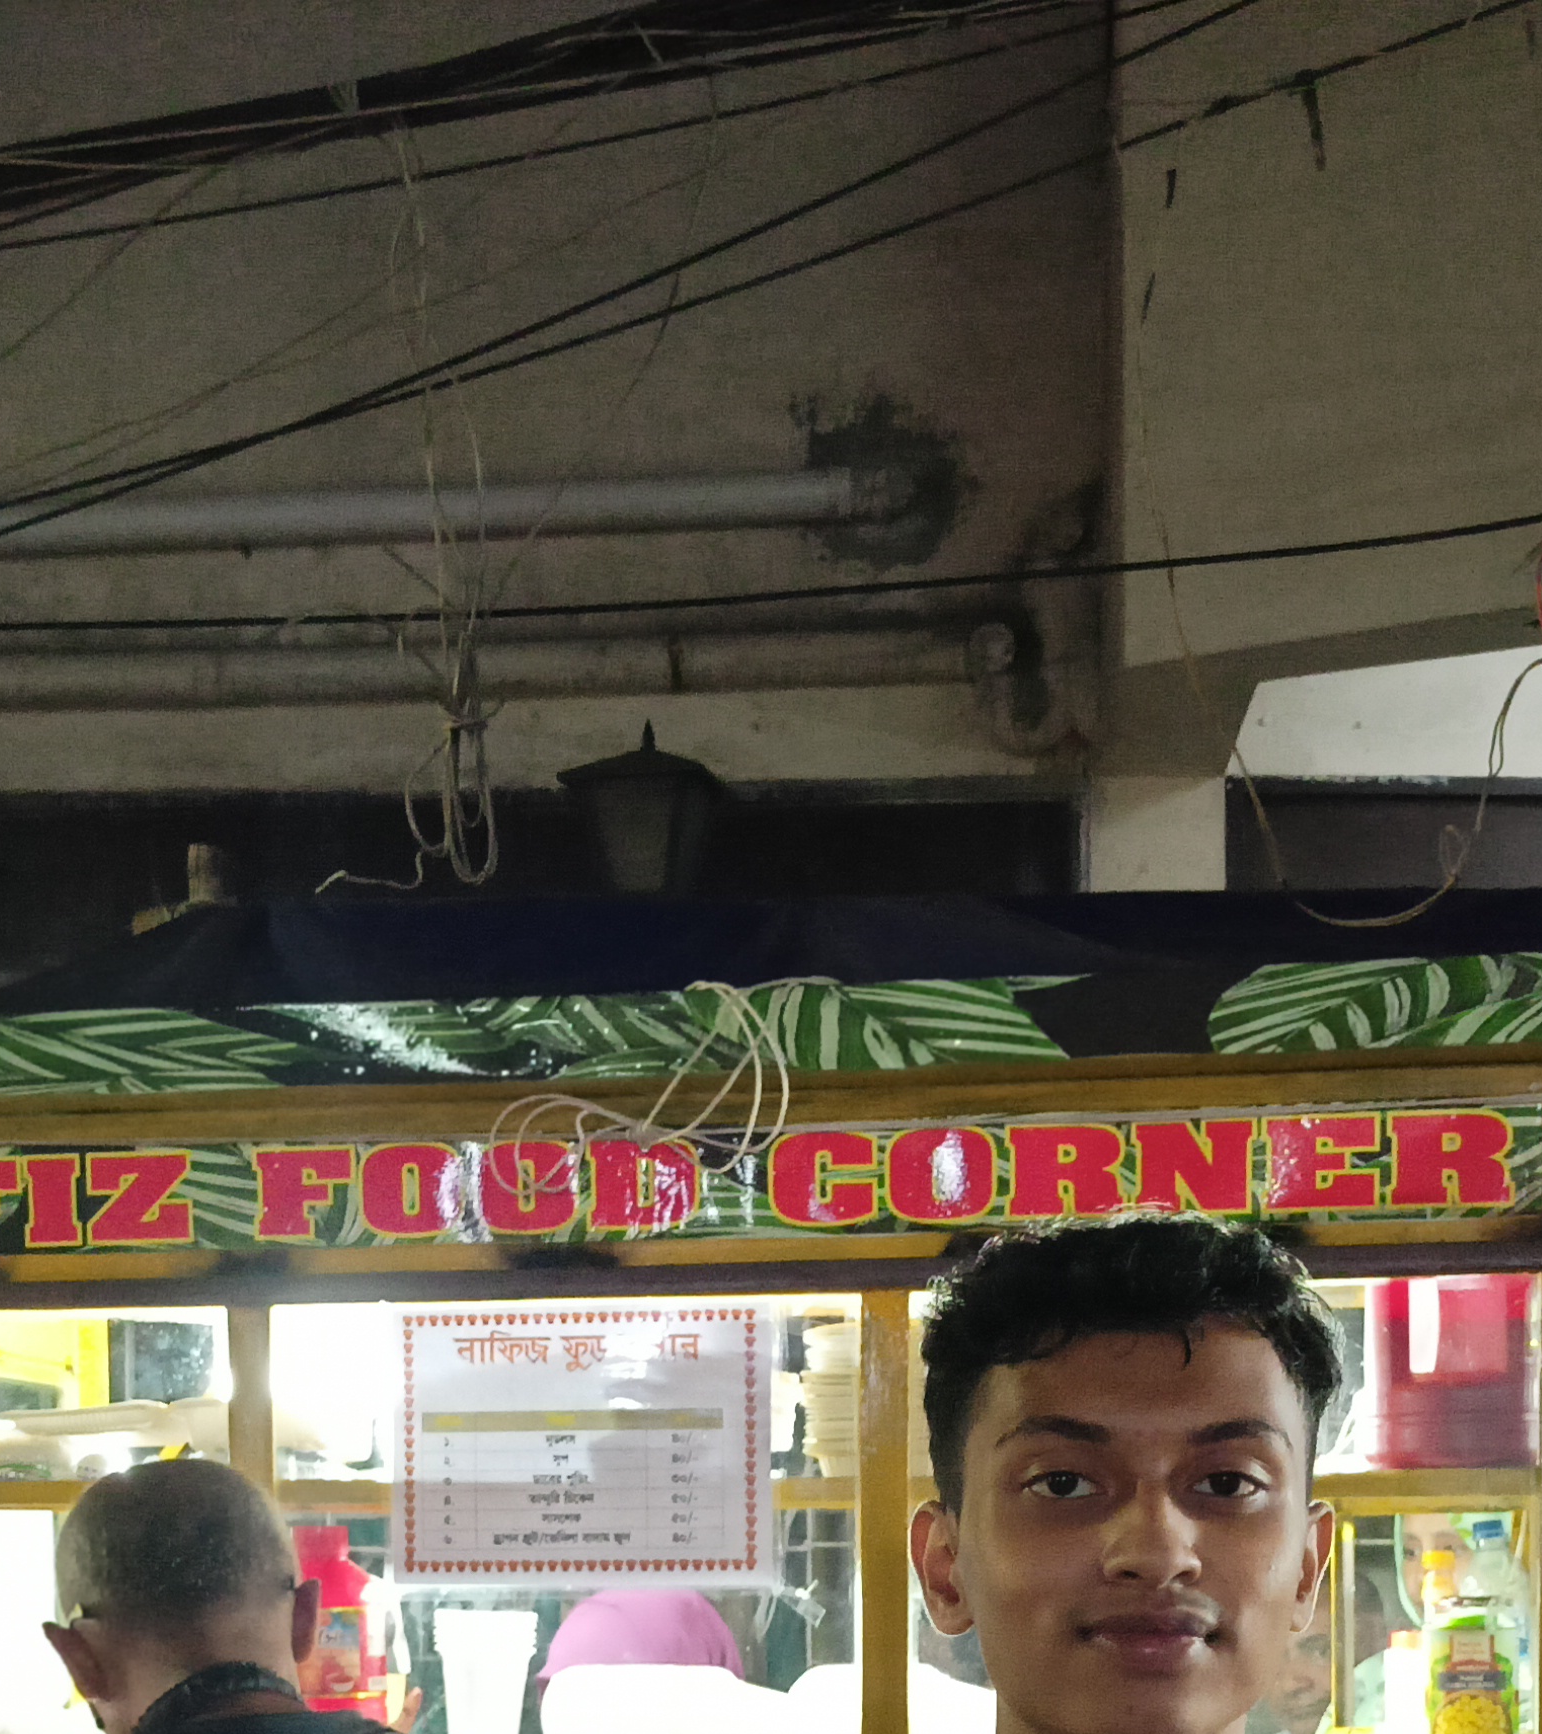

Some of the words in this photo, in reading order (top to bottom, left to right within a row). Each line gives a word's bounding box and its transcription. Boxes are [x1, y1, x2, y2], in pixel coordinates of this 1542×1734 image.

[256, 1136, 701, 1243] FOOD
[767, 1107, 1516, 1227] CORNER
[453, 1331, 551, 1364] নাফিজ
